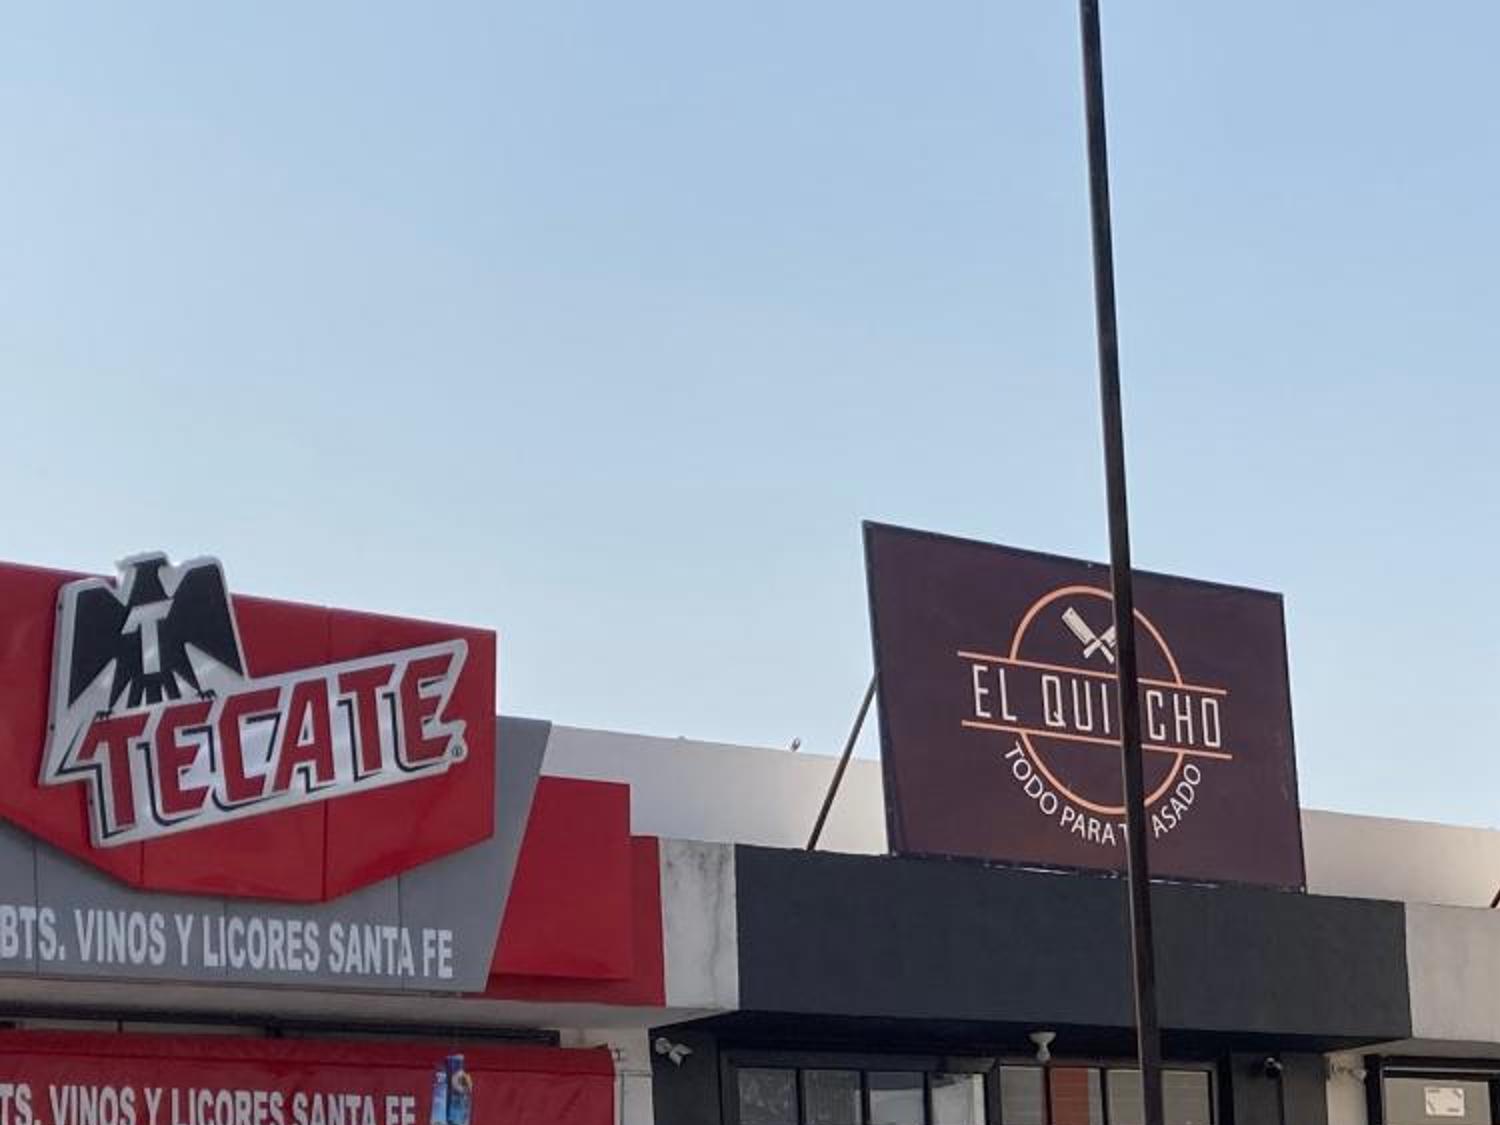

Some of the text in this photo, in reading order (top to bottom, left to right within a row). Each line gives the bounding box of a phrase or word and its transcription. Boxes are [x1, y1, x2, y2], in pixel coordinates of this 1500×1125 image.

[72, 651, 457, 834] TECATE
[973, 664, 1222, 749] EL QUICHO
[1003, 741, 1058, 815] TODO
[1059, 806, 1116, 848] PARA
[1151, 762, 1202, 839] ASADO
[0, 904, 454, 979] BTS. VINOS Y LICORES SANTA FE
